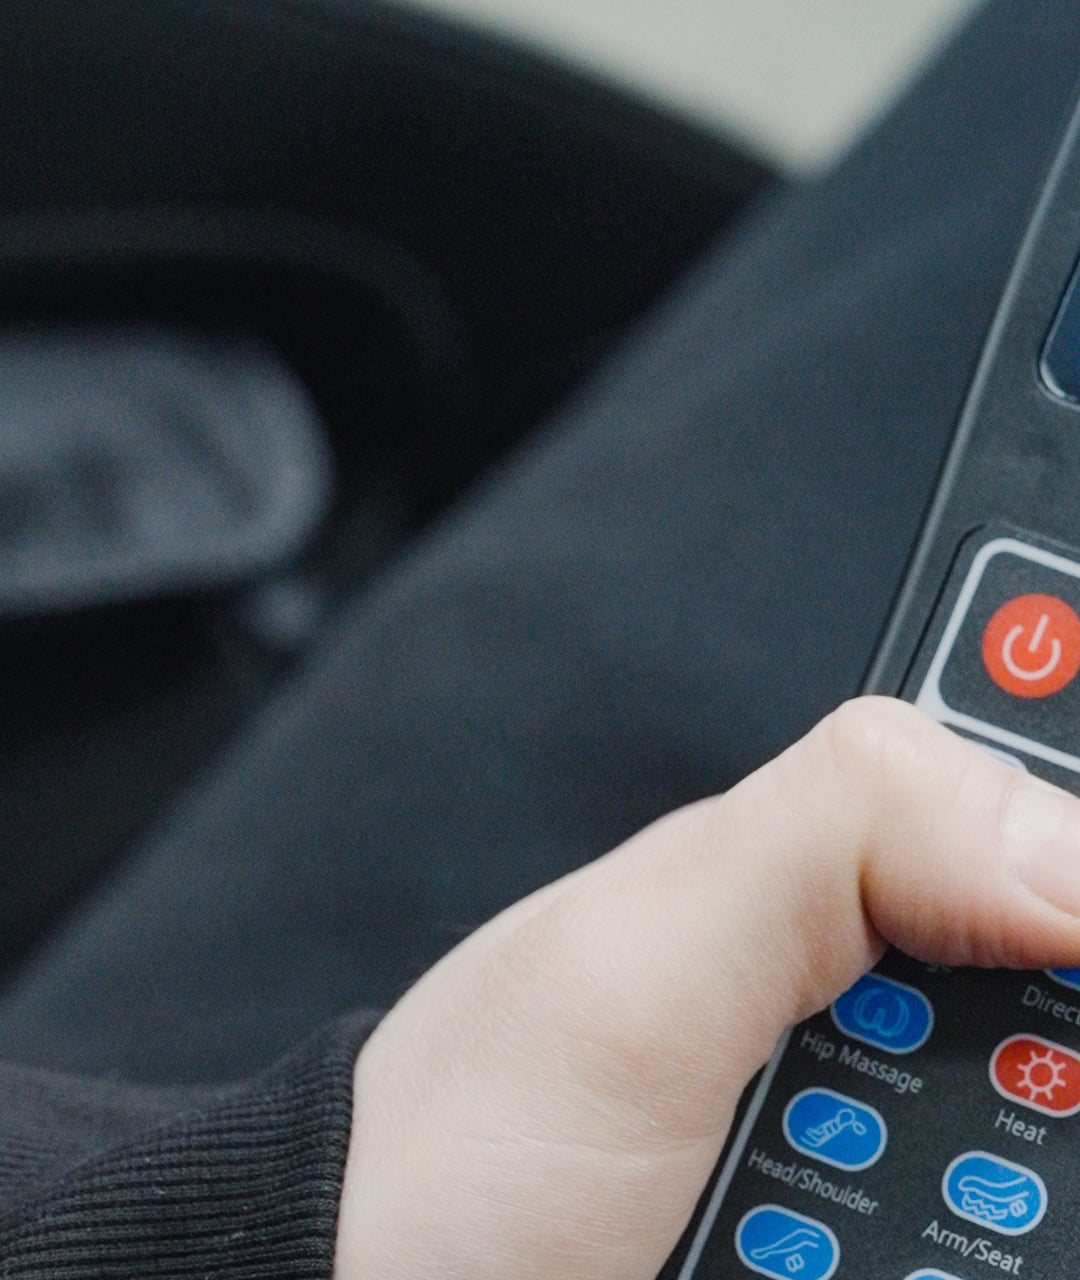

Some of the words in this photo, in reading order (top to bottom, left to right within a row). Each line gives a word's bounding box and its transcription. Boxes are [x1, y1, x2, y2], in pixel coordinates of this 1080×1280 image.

[801, 1029, 835, 1063] Hip
[837, 1047, 923, 1095] Massage
[994, 1109, 1048, 1146] Heat
[747, 1148, 880, 1217] Head/Shoulder
[921, 1220, 1024, 1276] Arm/Seat
